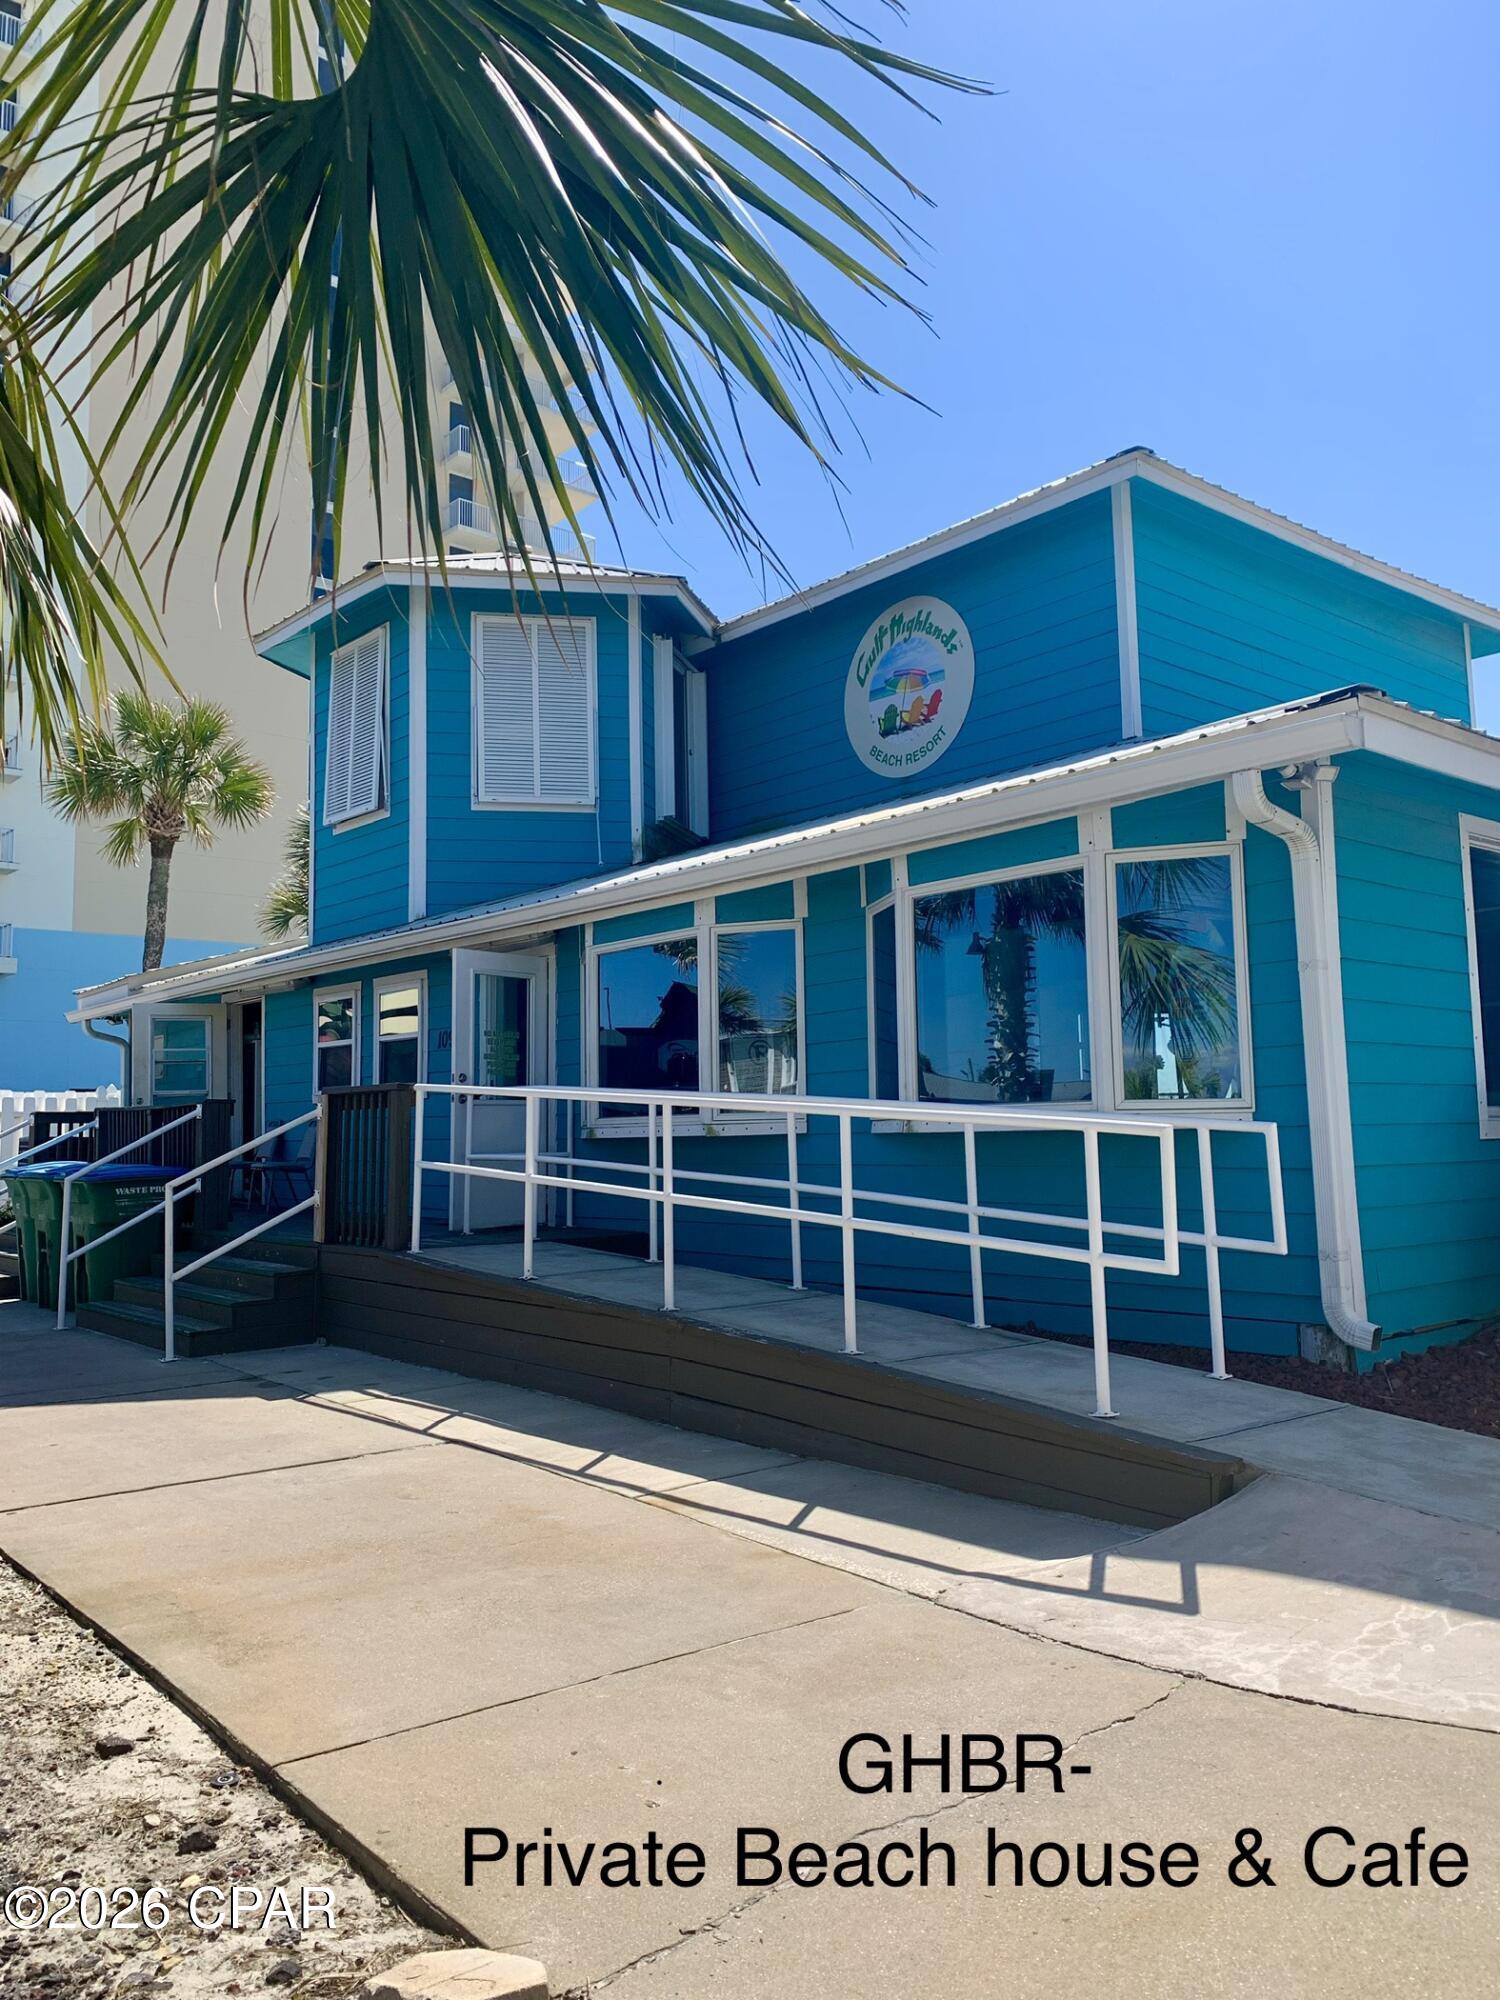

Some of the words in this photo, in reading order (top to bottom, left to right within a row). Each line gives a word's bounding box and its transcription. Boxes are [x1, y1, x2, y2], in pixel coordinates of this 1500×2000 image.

[856, 624, 889, 689] Gulf
[889, 609, 958, 655] Highlands
[869, 745, 903, 768] BEACH
[905, 725, 946, 766] RESORT
[115, 1185, 148, 1196] WASTE
